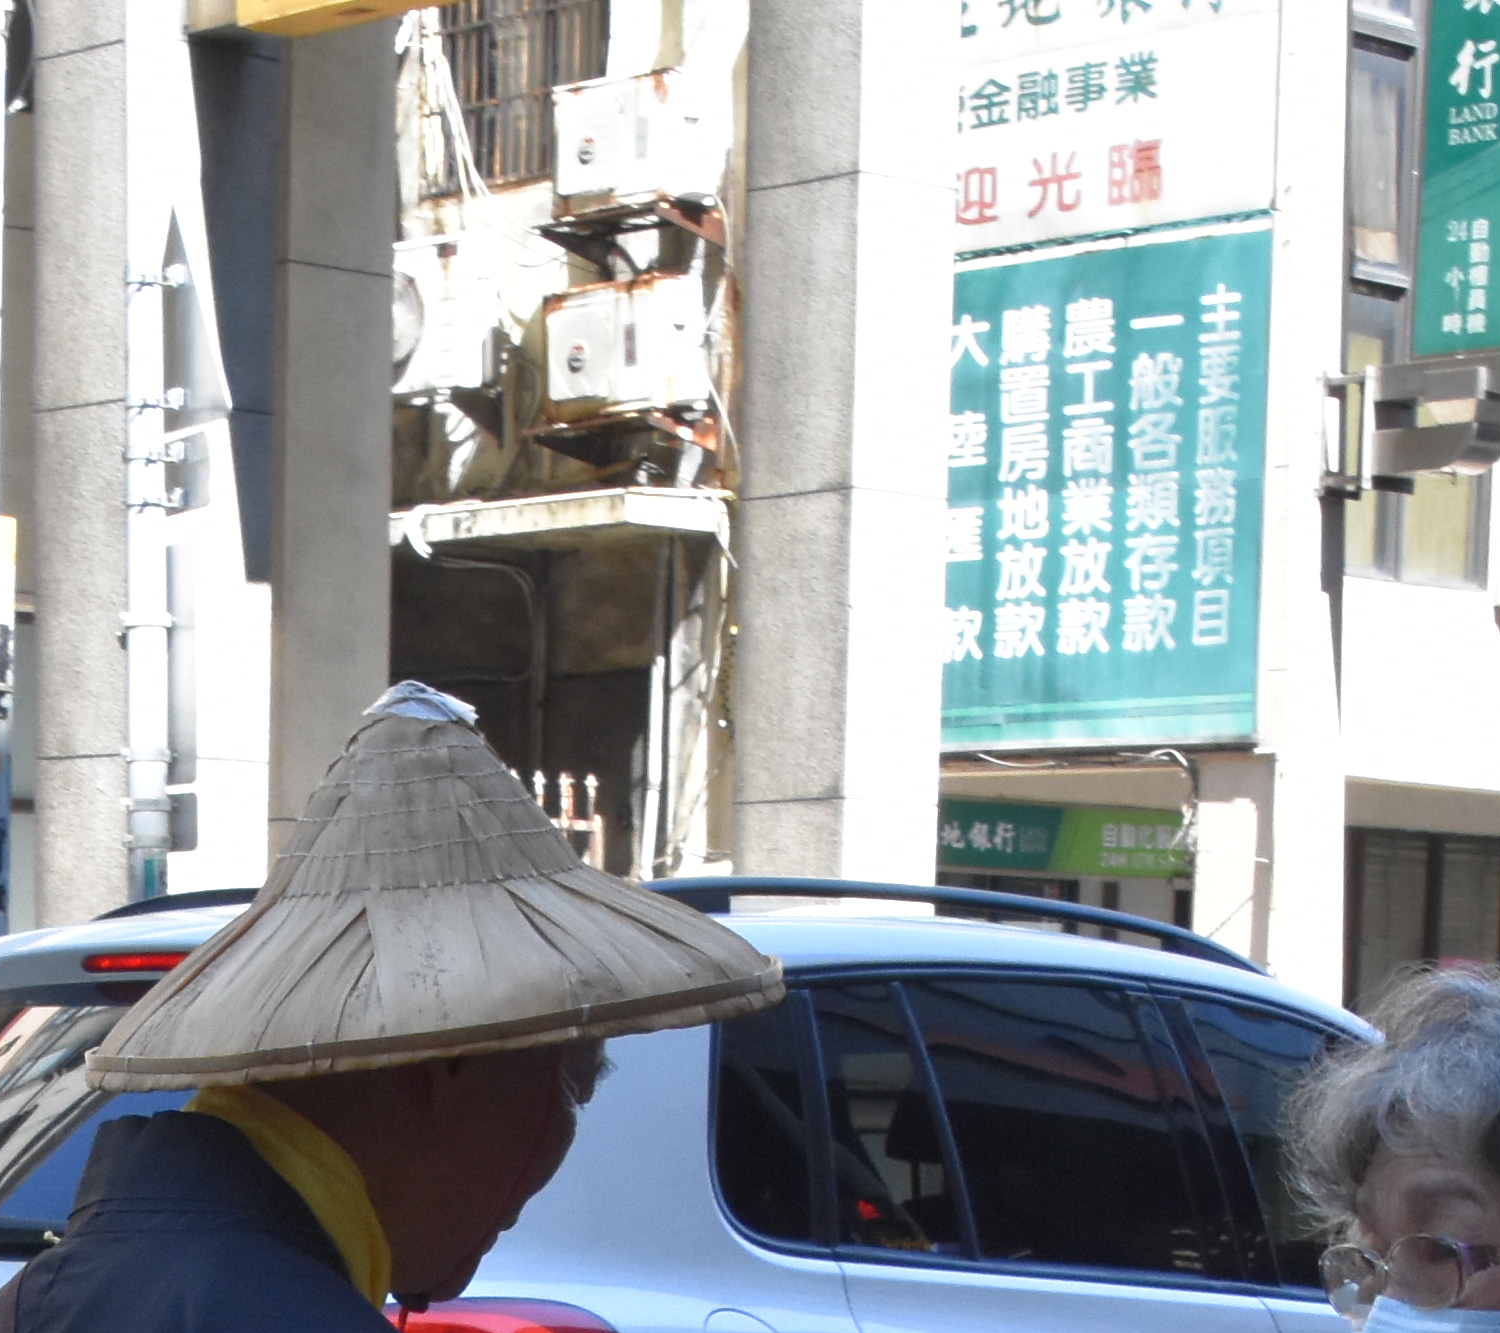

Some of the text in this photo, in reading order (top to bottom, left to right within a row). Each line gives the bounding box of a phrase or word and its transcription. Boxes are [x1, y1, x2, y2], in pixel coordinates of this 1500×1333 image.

[955, 139, 1163, 226] 迎光臨
[958, 51, 1159, 133] 金融事業
[1448, 123, 1498, 146] BANK
[1449, 102, 1498, 124] LAND
[992, 303, 1052, 659] 購置房地放款
[1056, 297, 1116, 655] 農工商業放款
[1121, 313, 1184, 653] 一般各類存款
[1191, 283, 1242, 646] 主要服務項目
